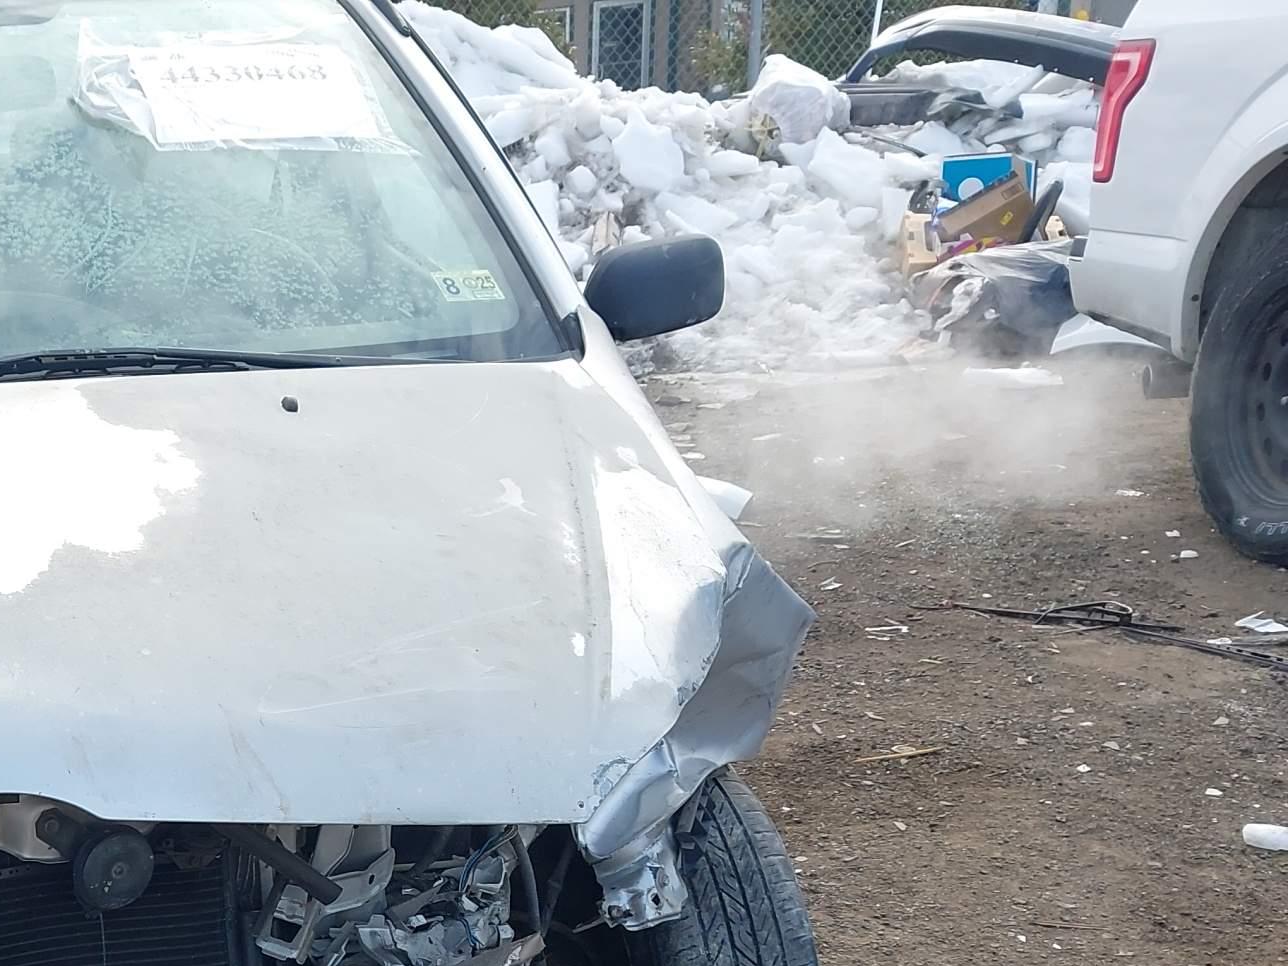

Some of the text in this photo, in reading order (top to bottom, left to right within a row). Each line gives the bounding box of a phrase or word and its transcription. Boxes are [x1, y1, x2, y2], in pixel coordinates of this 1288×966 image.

[160, 65, 327, 83] 44330468
[443, 278, 460, 295] 8
[476, 276, 496, 289] 25
